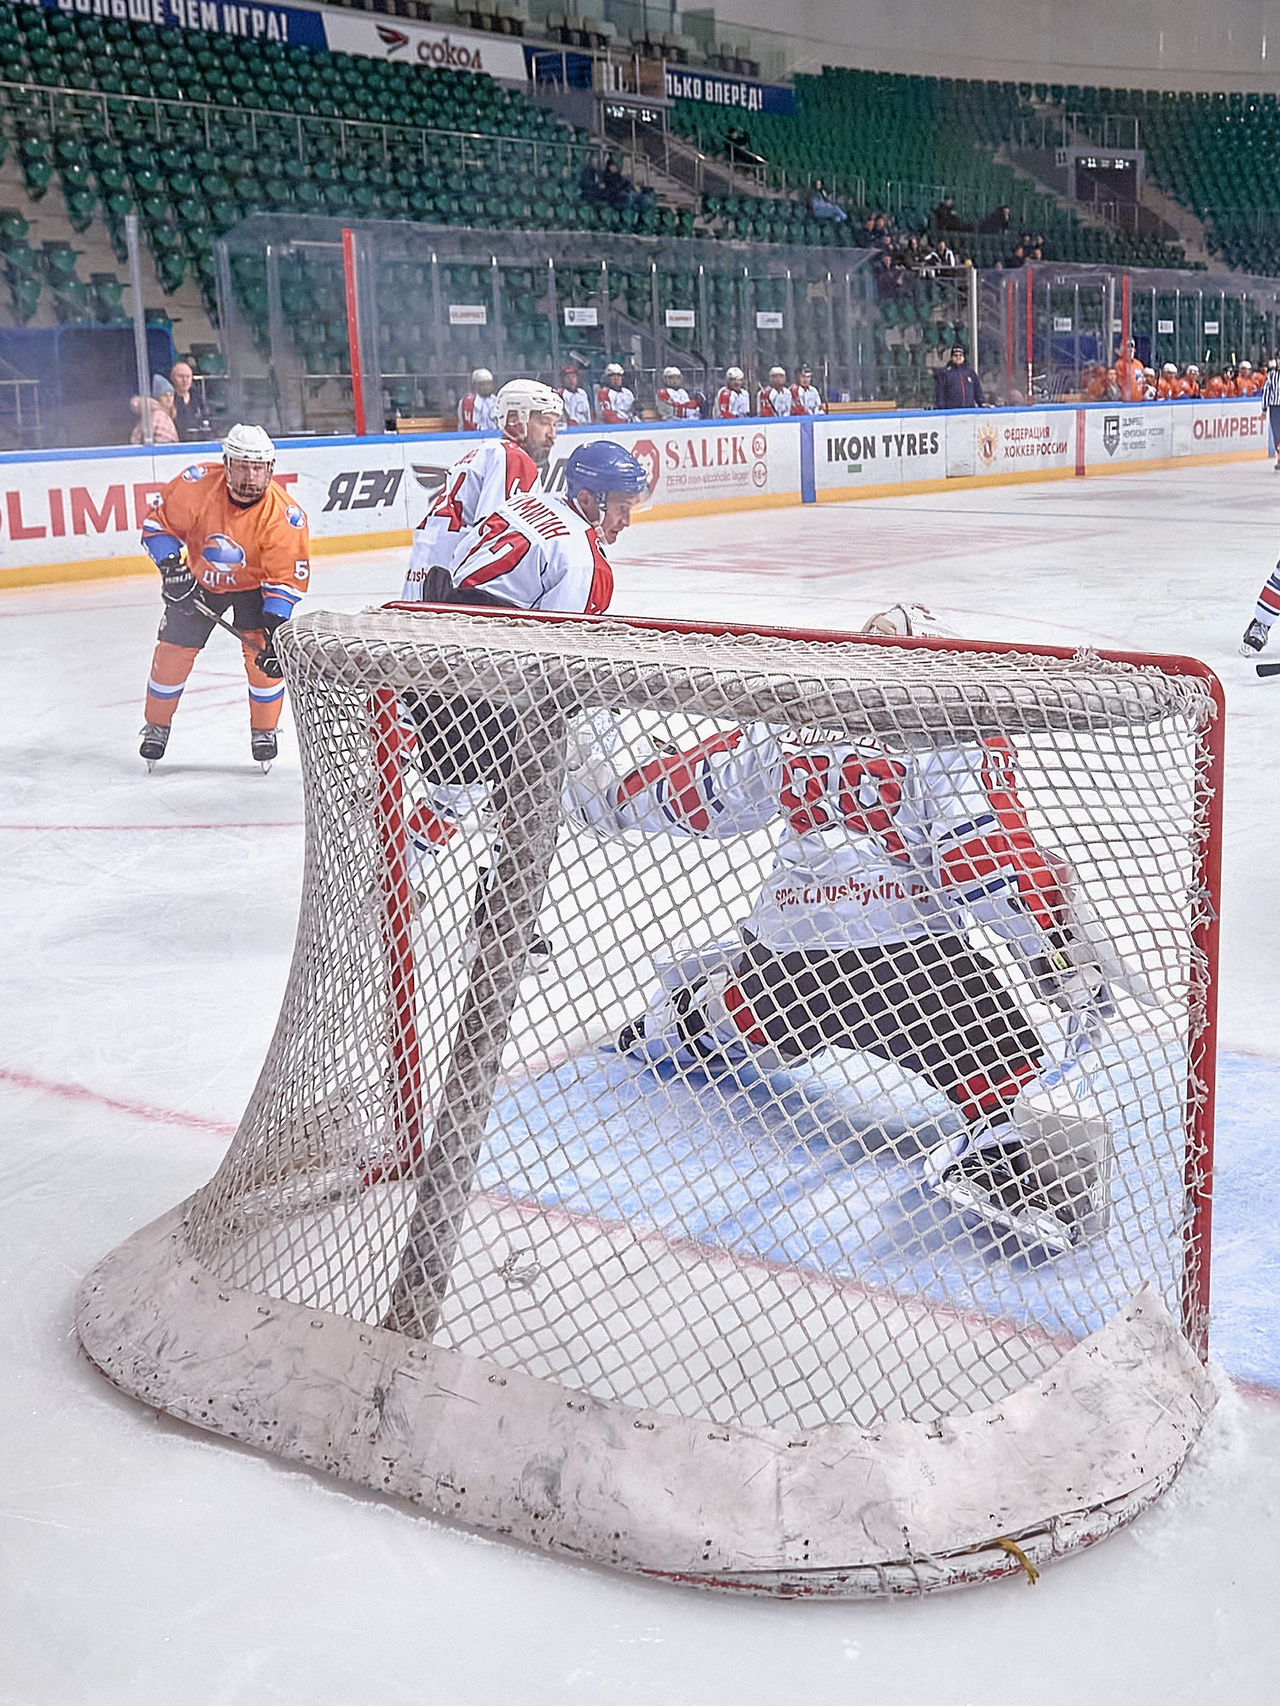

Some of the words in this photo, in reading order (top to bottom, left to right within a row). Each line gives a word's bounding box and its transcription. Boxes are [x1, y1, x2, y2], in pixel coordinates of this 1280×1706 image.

[170, 0, 219, 33] ЧЕМ
[222, 3, 289, 43] ИГРА!
[1004, 426, 1050, 442] ФЕДЕРАЦИЯ
[1193, 415, 1266, 440] OLIMPBET
[665, 436, 748, 470] SALEK
[827, 436, 877, 462] IKON
[882, 431, 940, 458] TYRES
[1004, 444, 1035, 458] ХОККЕЯ
[1036, 441, 1068, 455] РОССИИ
